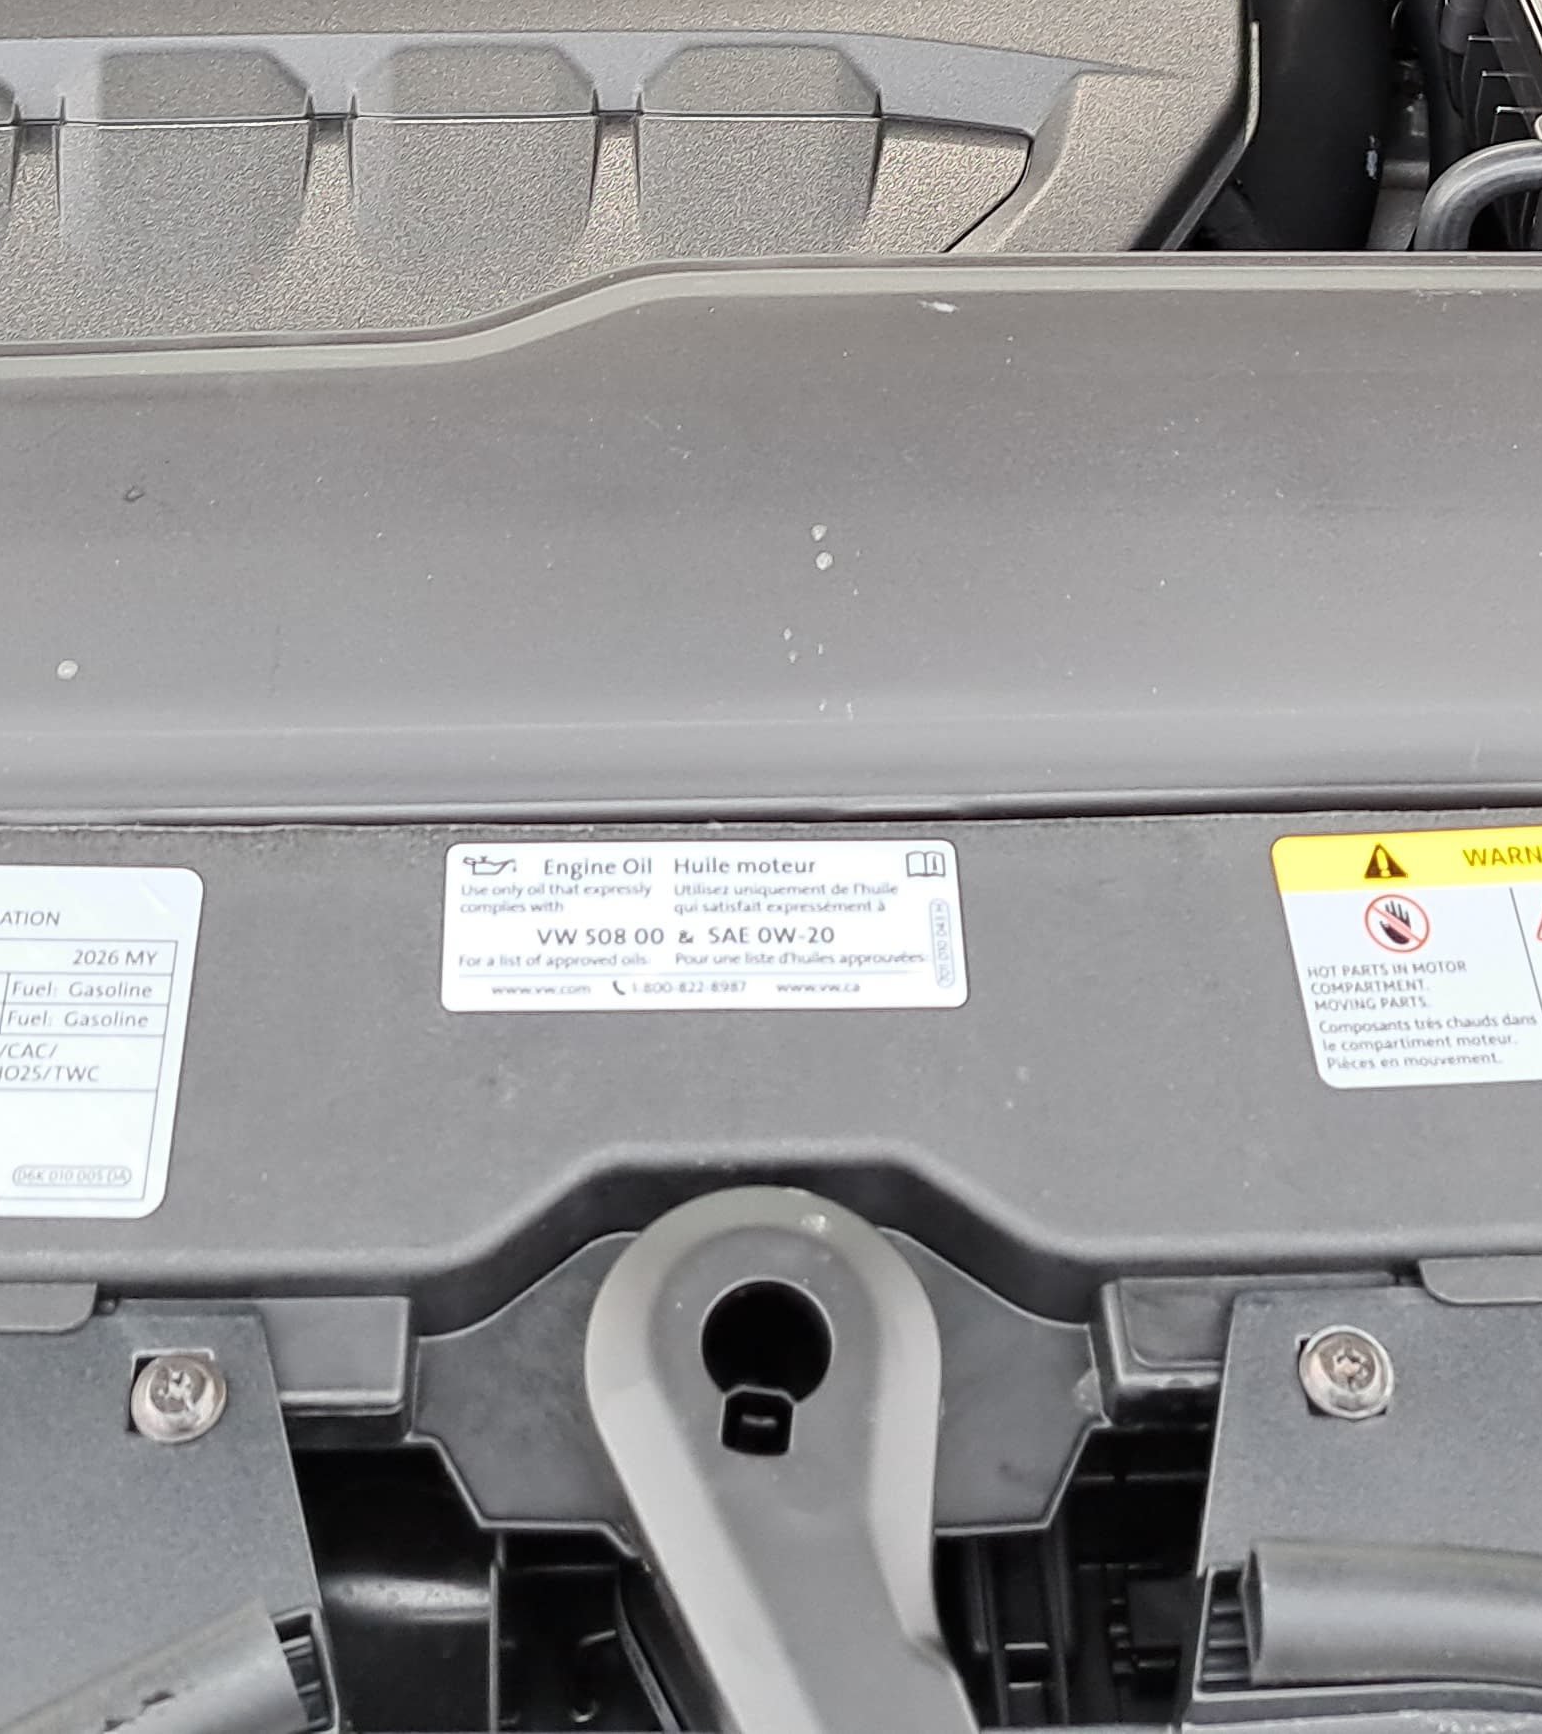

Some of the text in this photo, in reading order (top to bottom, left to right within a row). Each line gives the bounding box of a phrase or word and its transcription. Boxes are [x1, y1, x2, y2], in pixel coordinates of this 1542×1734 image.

[544, 858, 653, 881] Engine Oil
[674, 858, 815, 874] Huile moteur
[461, 884, 652, 899] Use only oil that expressly
[674, 883, 728, 896] Utilisez
[734, 884, 826, 898] uniquement
[831, 884, 848, 895] de
[460, 901, 564, 915] complies with
[674, 901, 885, 915] qui satisfait expressément à
[537, 927, 835, 946] VW 508 00 & SAE 0W-20
[72, 950, 158, 966] 2026 MY
[459, 954, 617, 968] For a list of approved
[675, 953, 709, 964] Pour
[719, 954, 739, 964] une
[745, 953, 774, 964] liste
[1308, 960, 1467, 979] HOT PARTS IN MOTOR
[12, 981, 153, 998] Fuel: Gasoline
[1315, 998, 1376, 1012] MOVING
[7, 1010, 149, 1028] Fuel: Gasoline
[1319, 1014, 1537, 1035] Composants très chauds dans
[1323, 1039, 1336, 1051] le
[1341, 1036, 1452, 1052] compartiment
[1327, 1056, 1375, 1070] Pièces
[1380, 1057, 1399, 1067] en
